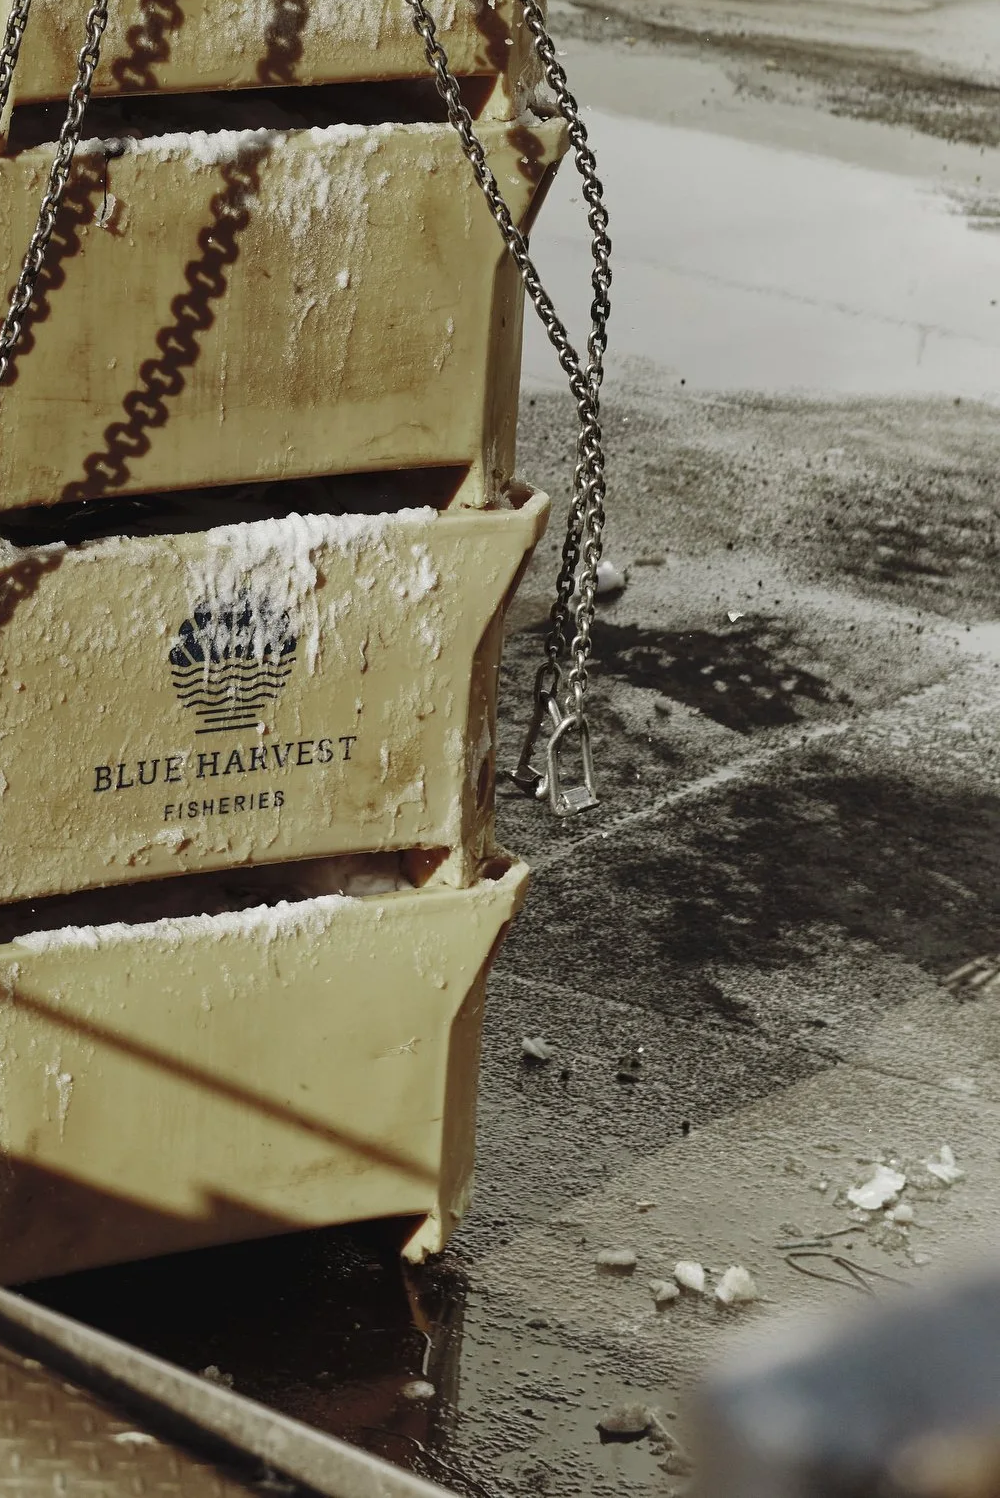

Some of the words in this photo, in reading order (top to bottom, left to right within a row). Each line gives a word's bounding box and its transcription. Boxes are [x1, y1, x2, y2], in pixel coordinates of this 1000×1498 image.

[92, 757, 185, 792] BLUE
[196, 735, 358, 778] HARVEST
[163, 790, 286, 821] FISHERIES
